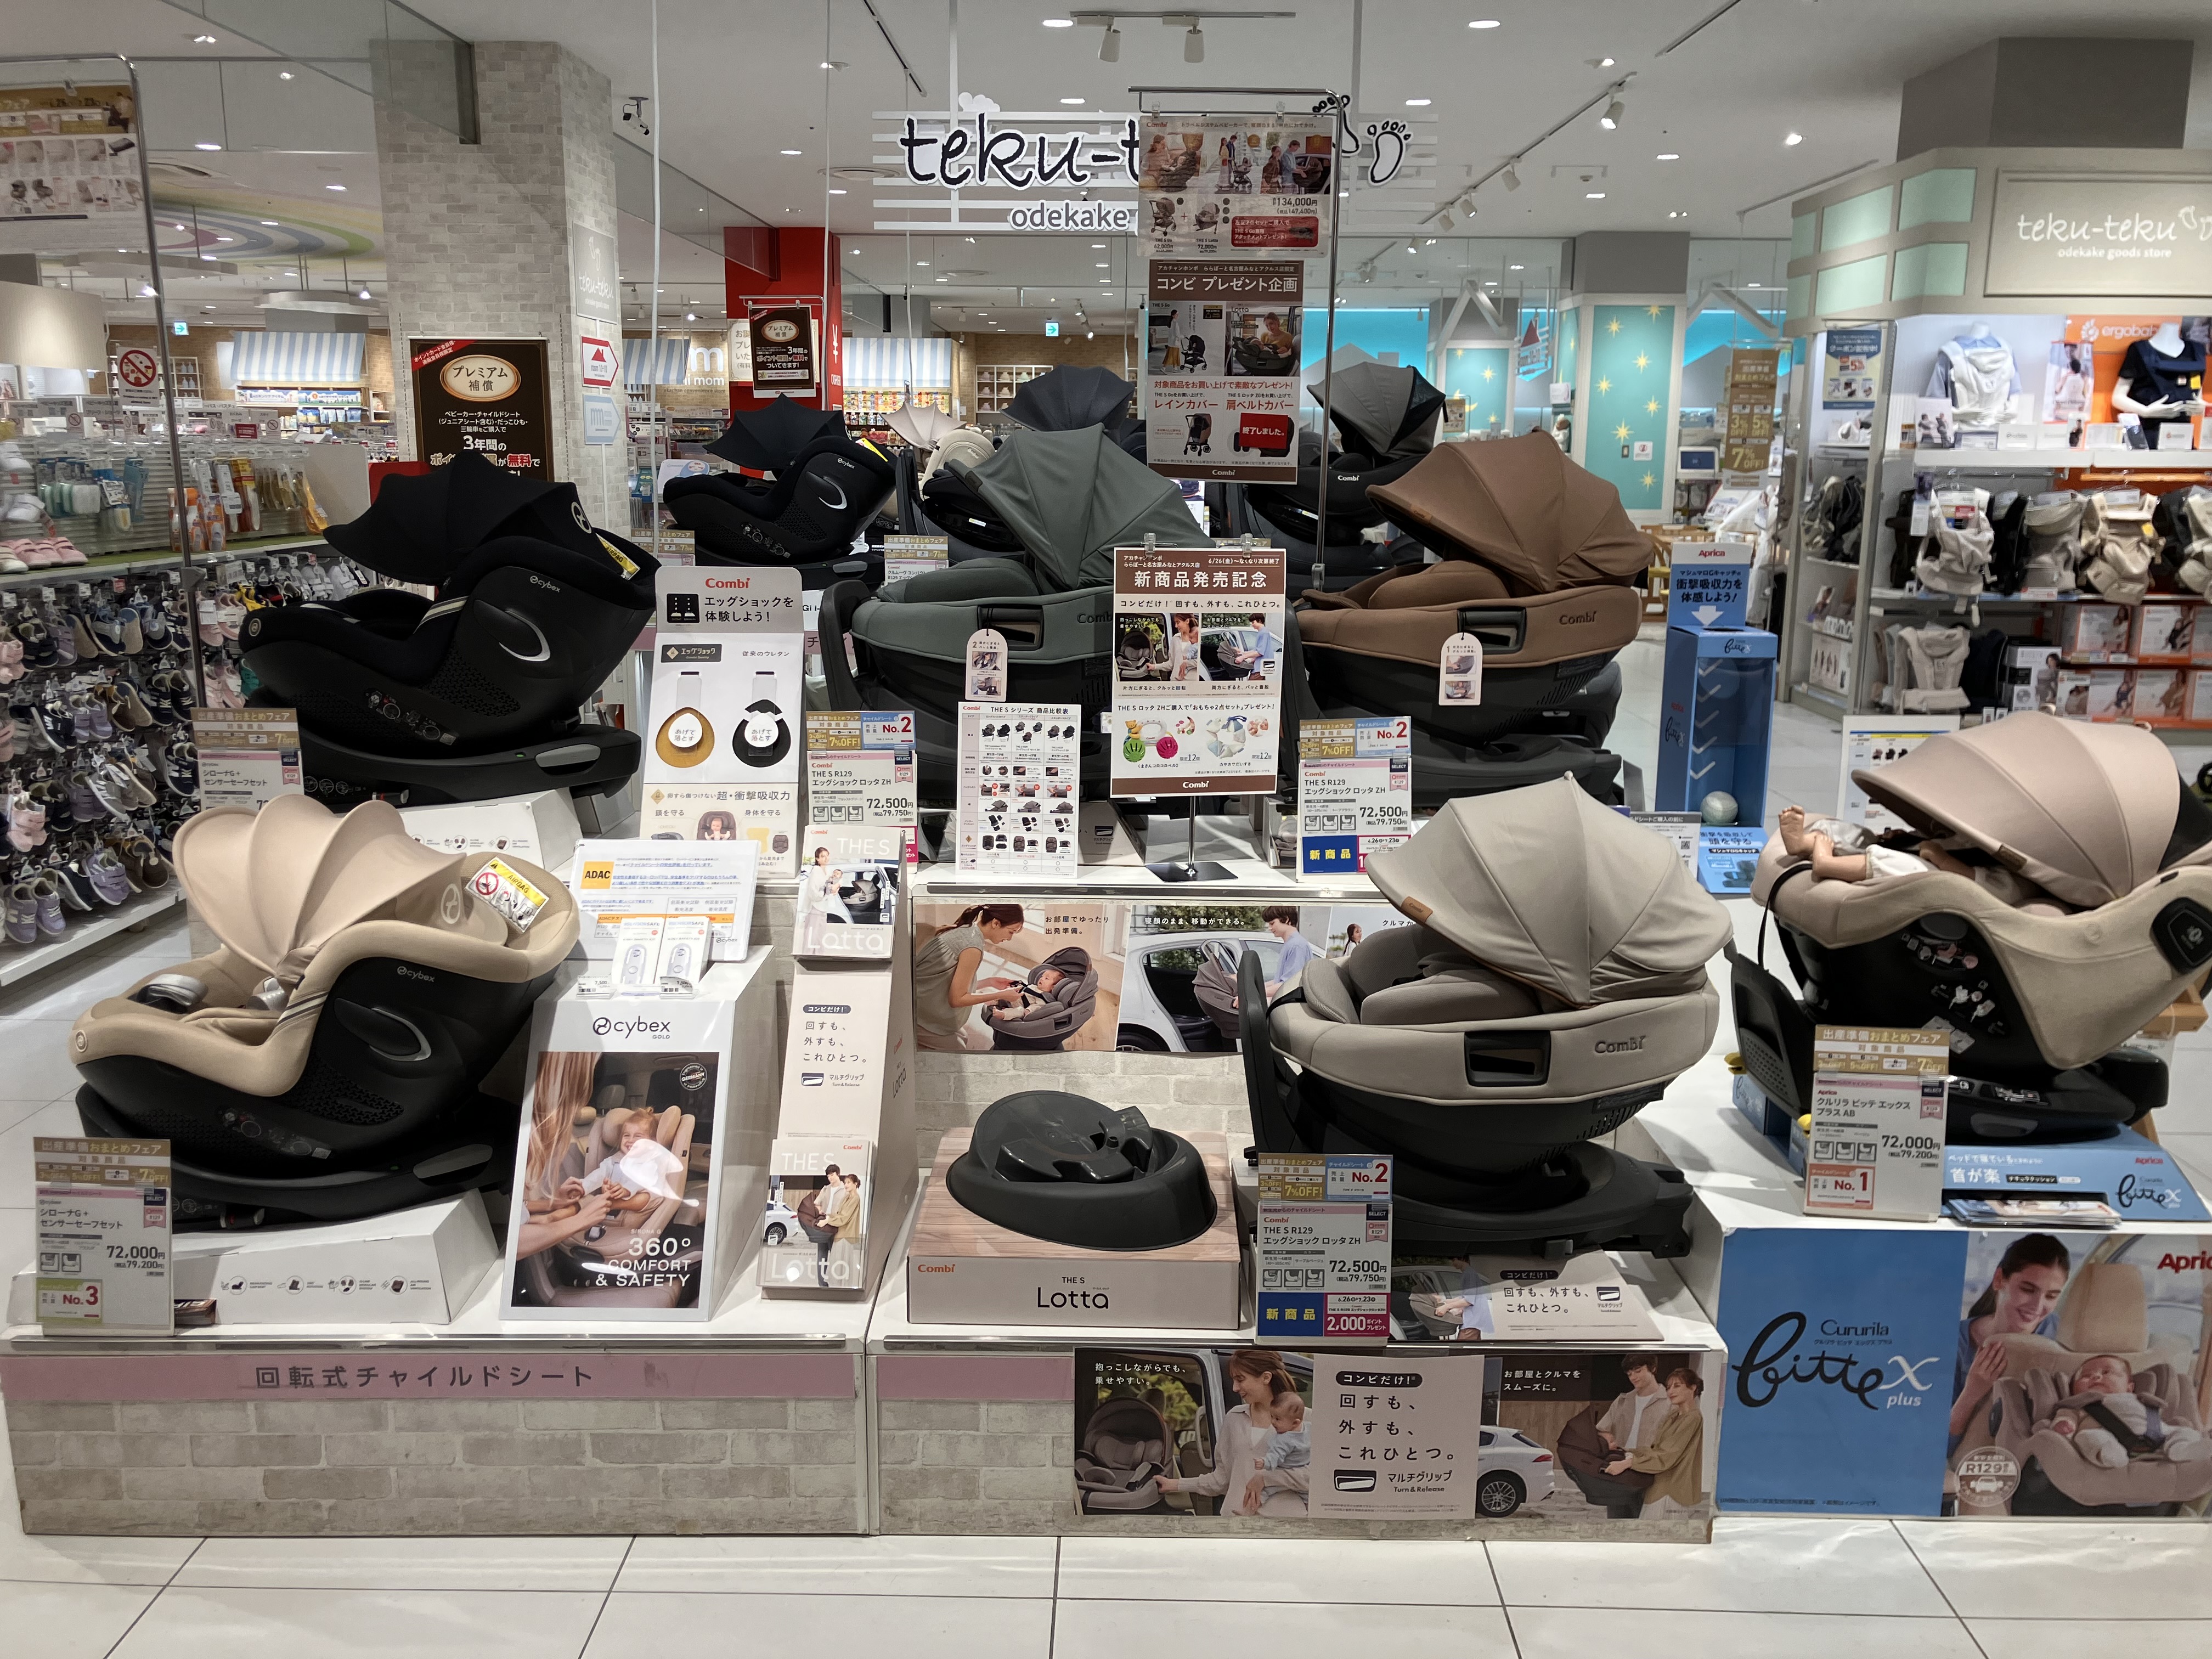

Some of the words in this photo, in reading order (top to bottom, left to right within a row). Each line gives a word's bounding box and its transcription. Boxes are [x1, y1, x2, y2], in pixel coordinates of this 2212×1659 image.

[900, 112, 1138, 187] teku-t
[1012, 202, 1127, 228] odekake
[2018, 212, 2177, 241] teku-teku
[2058, 247, 2104, 257] odekake
[2107, 247, 2141, 260] goods
[2144, 247, 2172, 257] store
[1157, 277, 1196, 290] コンビ
[1203, 276, 1297, 292] プレゼント企画
[2102, 325, 2159, 339] ergobab
[453, 366, 508, 379] プレミアム
[469, 381, 494, 392] 補償
[1155, 400, 1218, 409] レインカバー
[1227, 400, 1294, 410] 肩ベルトカバー
[1243, 427, 1284, 436] 終了しました。
[463, 436, 506, 450] 3年間の
[843, 461, 855, 469] cybex
[606, 546, 623, 562] AIRBAG
[1699, 549, 1726, 558] Aprica
[706, 578, 750, 589] Combi
[1135, 571, 1266, 588] 新商品発売記念
[1677, 579, 1742, 589] 衝撃吸収力を
[538, 581, 560, 592] cybex
[705, 596, 793, 607] エッグショックを
[706, 611, 771, 622] 体験しよう!
[1077, 611, 1113, 623] Comb
[1559, 611, 1597, 625] Combi
[883, 717, 911, 733] No.2
[1378, 721, 1407, 739] No.2
[830, 737, 860, 747] 7%OFF!
[1322, 746, 1353, 755] 7%OFF!
[717, 791, 790, 800] 超・衝撃吸収力
[867, 798, 913, 809] 72,500円
[1360, 806, 1408, 817] 72,500円
[837, 838, 873, 854] THE
[879, 840, 889, 855] S
[1310, 849, 1351, 860] 新商品
[585, 870, 611, 879] ADAC
[507, 874, 529, 893] AIRBAG
[1144, 918, 1245, 926] 寝顔のまま、移動ができる。
[807, 926, 884, 951] Lotta
[407, 969, 435, 982] cybex
[614, 1016, 670, 1038] cybex
[805, 1021, 846, 1031] 回すも、
[804, 1036, 844, 1046] 外すも、
[1595, 1035, 1646, 1053] Combi
[803, 1053, 867, 1063] これひとつ。
[681, 1072, 704, 1081] GERMANY
[893, 1068, 906, 1098] Lotta
[1817, 1098, 1849, 1107] クルリラ
[1882, 1135, 1940, 1149] 72,000円
[782, 1153, 815, 1170] THE
[1352, 1163, 1388, 1182] No.2
[1950, 1169, 2000, 1184] 首が楽
[1835, 1172, 1867, 1191] No.1
[1285, 1187, 1322, 1197] 7%OFF!
[41, 1220, 123, 1228] センサーセーフセット
[106, 1246, 165, 1259] 72,000円
[608, 1260, 691, 1271] COMFORT
[771, 1253, 850, 1280] Lotta
[917, 1263, 955, 1273] Combi
[1330, 1261, 1387, 1273] 72,500円
[2158, 1251, 2212, 1273] Apric
[596, 1275, 607, 1285] &
[616, 1274, 690, 1287] SAFETY
[63, 1286, 98, 1305] No.3
[1038, 1288, 1109, 1309] Lotta
[1267, 1308, 1316, 1321] 新商品
[1506, 1304, 1568, 1314] これひとつ。
[1327, 1317, 1366, 1331] 2,000
[1820, 1319, 1889, 1336] Cururila
[1095, 1363, 1186, 1373] 抱っこしながらでも、
[1504, 1370, 1581, 1379] お部屋とクルマを
[256, 1365, 591, 1389] 回転式チャイルドシート
[1095, 1375, 1151, 1385] 乗せやすい。
[1504, 1383, 1558, 1392] スムーズに。
[1340, 1394, 1415, 1410] 回すも、
[1886, 1392, 1922, 1409] plus
[1339, 1419, 1414, 1436] 外すも、
[1339, 1446, 1454, 1461] これひとつ。
[1388, 1470, 1453, 1483] マルチグリップ
